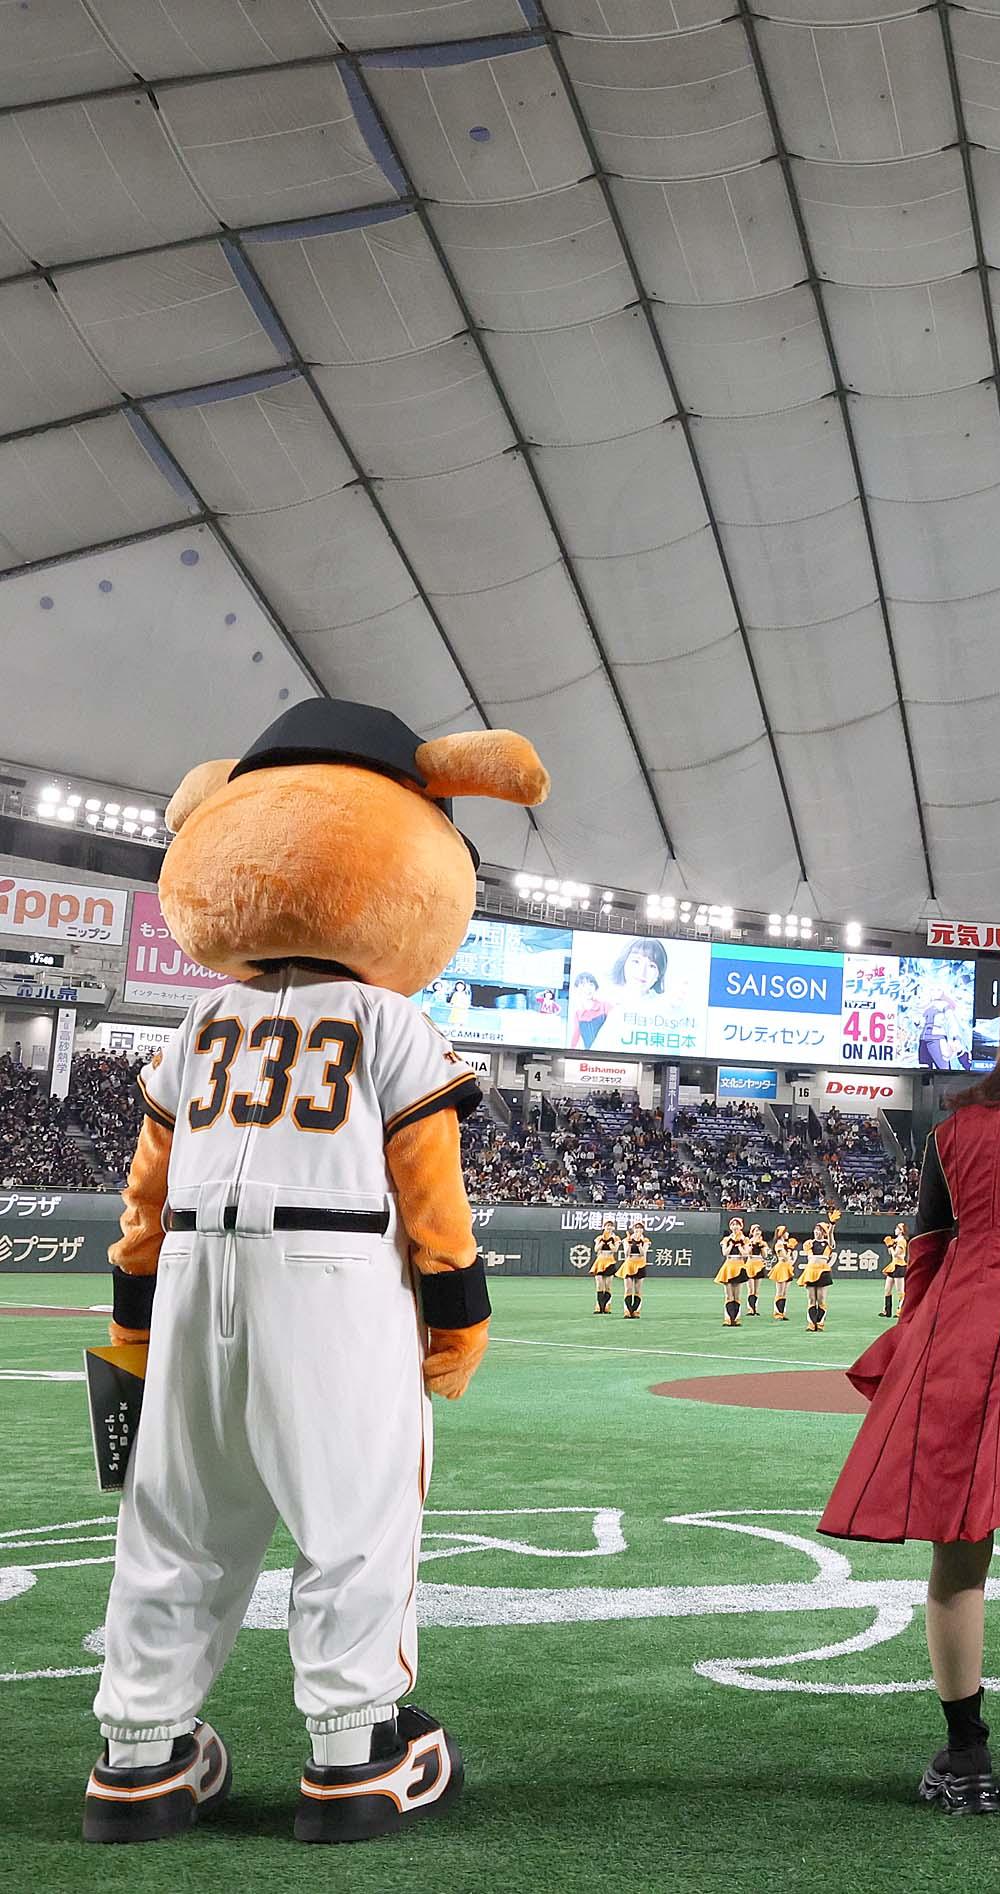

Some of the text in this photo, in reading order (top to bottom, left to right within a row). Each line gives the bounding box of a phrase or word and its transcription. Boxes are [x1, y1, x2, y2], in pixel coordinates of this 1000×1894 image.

[66, 926, 111, 940] ニップン
[140, 922, 176, 941] もっ
[726, 971, 828, 1001] SAISON
[843, 1011, 887, 1043] 4.6
[139, 1033, 170, 1043] FUDE
[620, 1030, 697, 1049] JR東日本
[842, 1043, 894, 1062] ON AIR
[188, 1015, 364, 1135] 333
[533, 1071, 541, 1083] 4
[798, 1087, 810, 1098] 16
[825, 1081, 894, 1100] Denyo
[0, 1194, 62, 1217] プラザ
[561, 1210, 685, 1232] 山形健康管理センター
